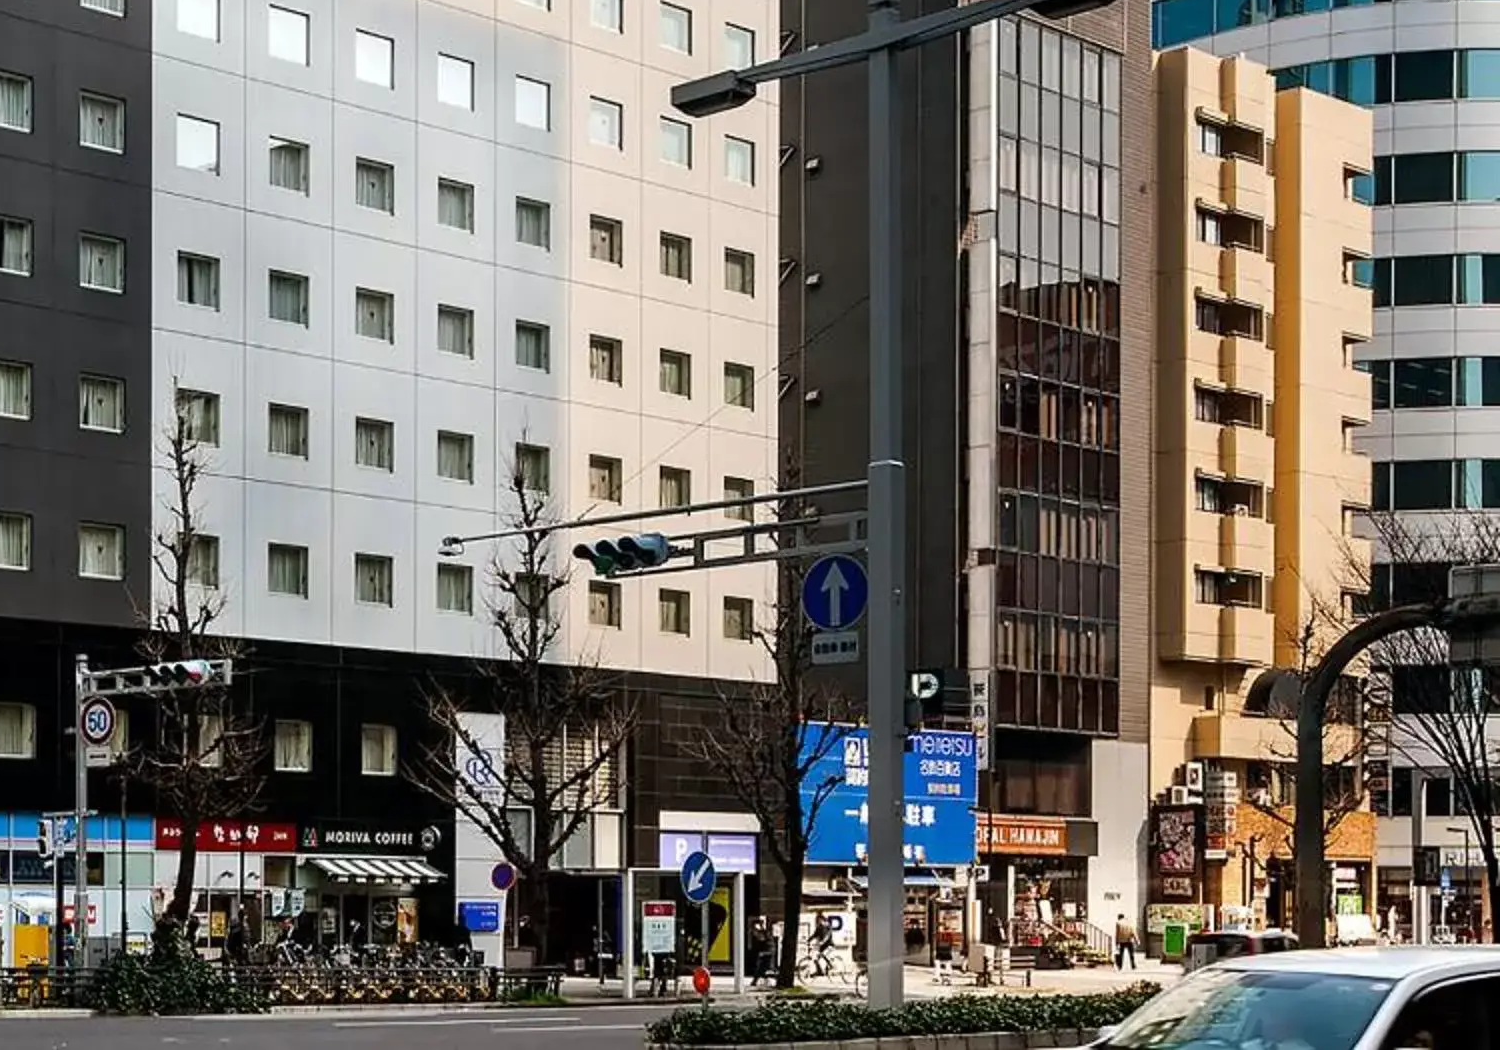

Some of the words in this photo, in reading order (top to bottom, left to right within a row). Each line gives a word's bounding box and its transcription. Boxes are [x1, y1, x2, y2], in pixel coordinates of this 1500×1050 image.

[88, 711, 107, 733] 50
[375, 831, 413, 846] COFFEE
[675, 837, 689, 863] P
[13, 858, 77, 877] LAWN
